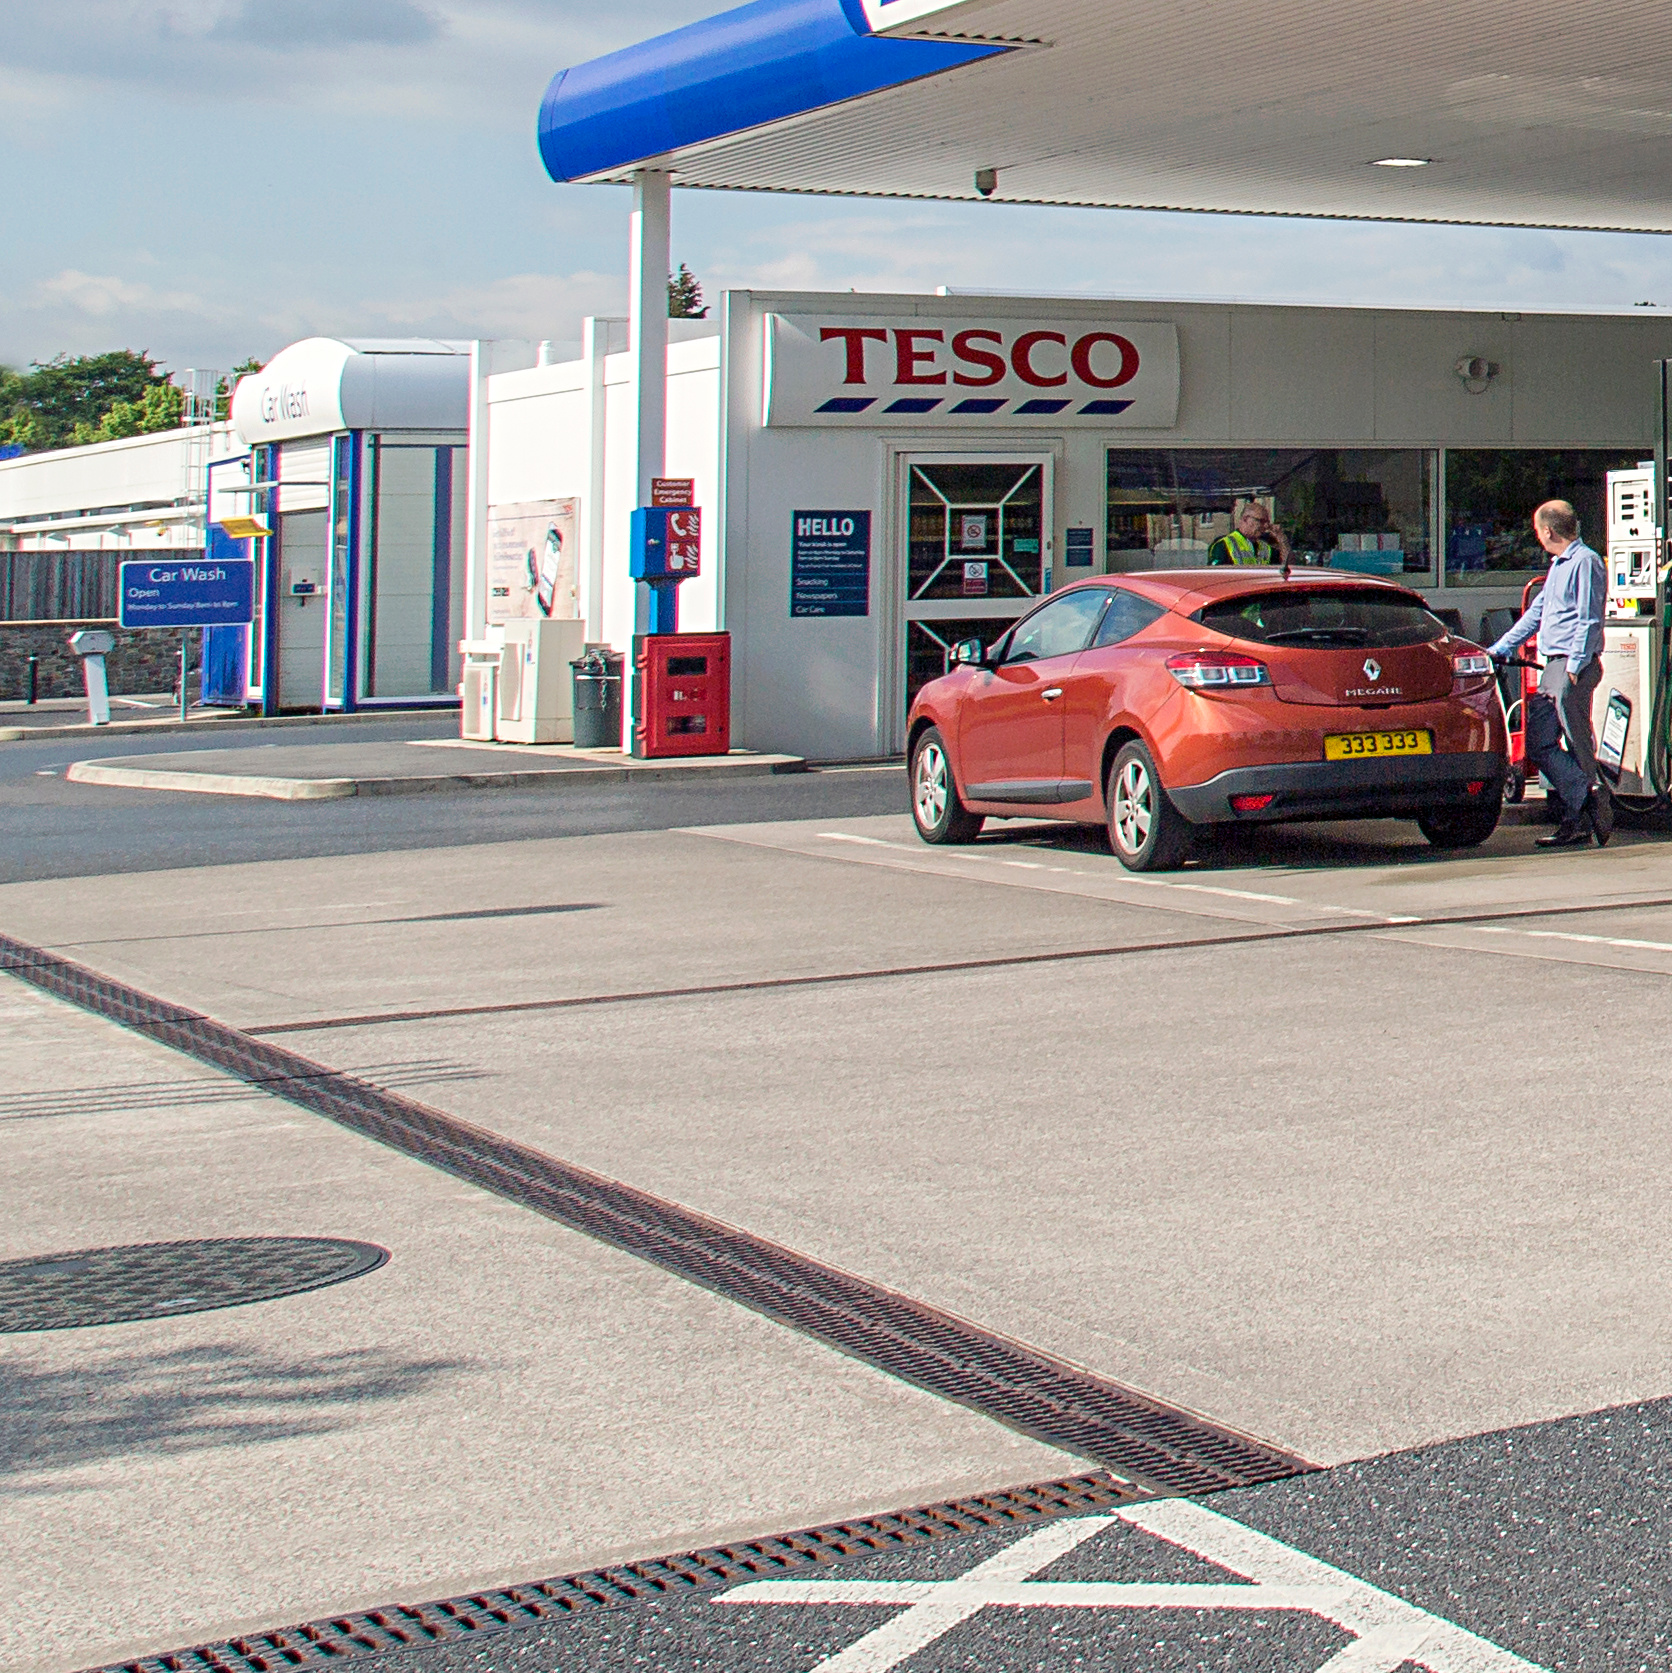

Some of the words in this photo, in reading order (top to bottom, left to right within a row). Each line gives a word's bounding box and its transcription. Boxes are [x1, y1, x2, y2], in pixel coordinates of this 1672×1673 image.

[820, 327, 1140, 389] TESCO
[261, 387, 278, 423] Car
[280, 381, 310, 419] Wash
[656, 480, 690, 488] Customer
[654, 488, 692, 497] Emergency
[659, 496, 687, 504] Cabinet
[798, 517, 854, 536] HELLO
[149, 568, 178, 582] Car
[181, 566, 226, 581] Wash
[128, 588, 160, 599] Open
[1341, 735, 1377, 754] 333
[1382, 732, 1418, 750] 333
